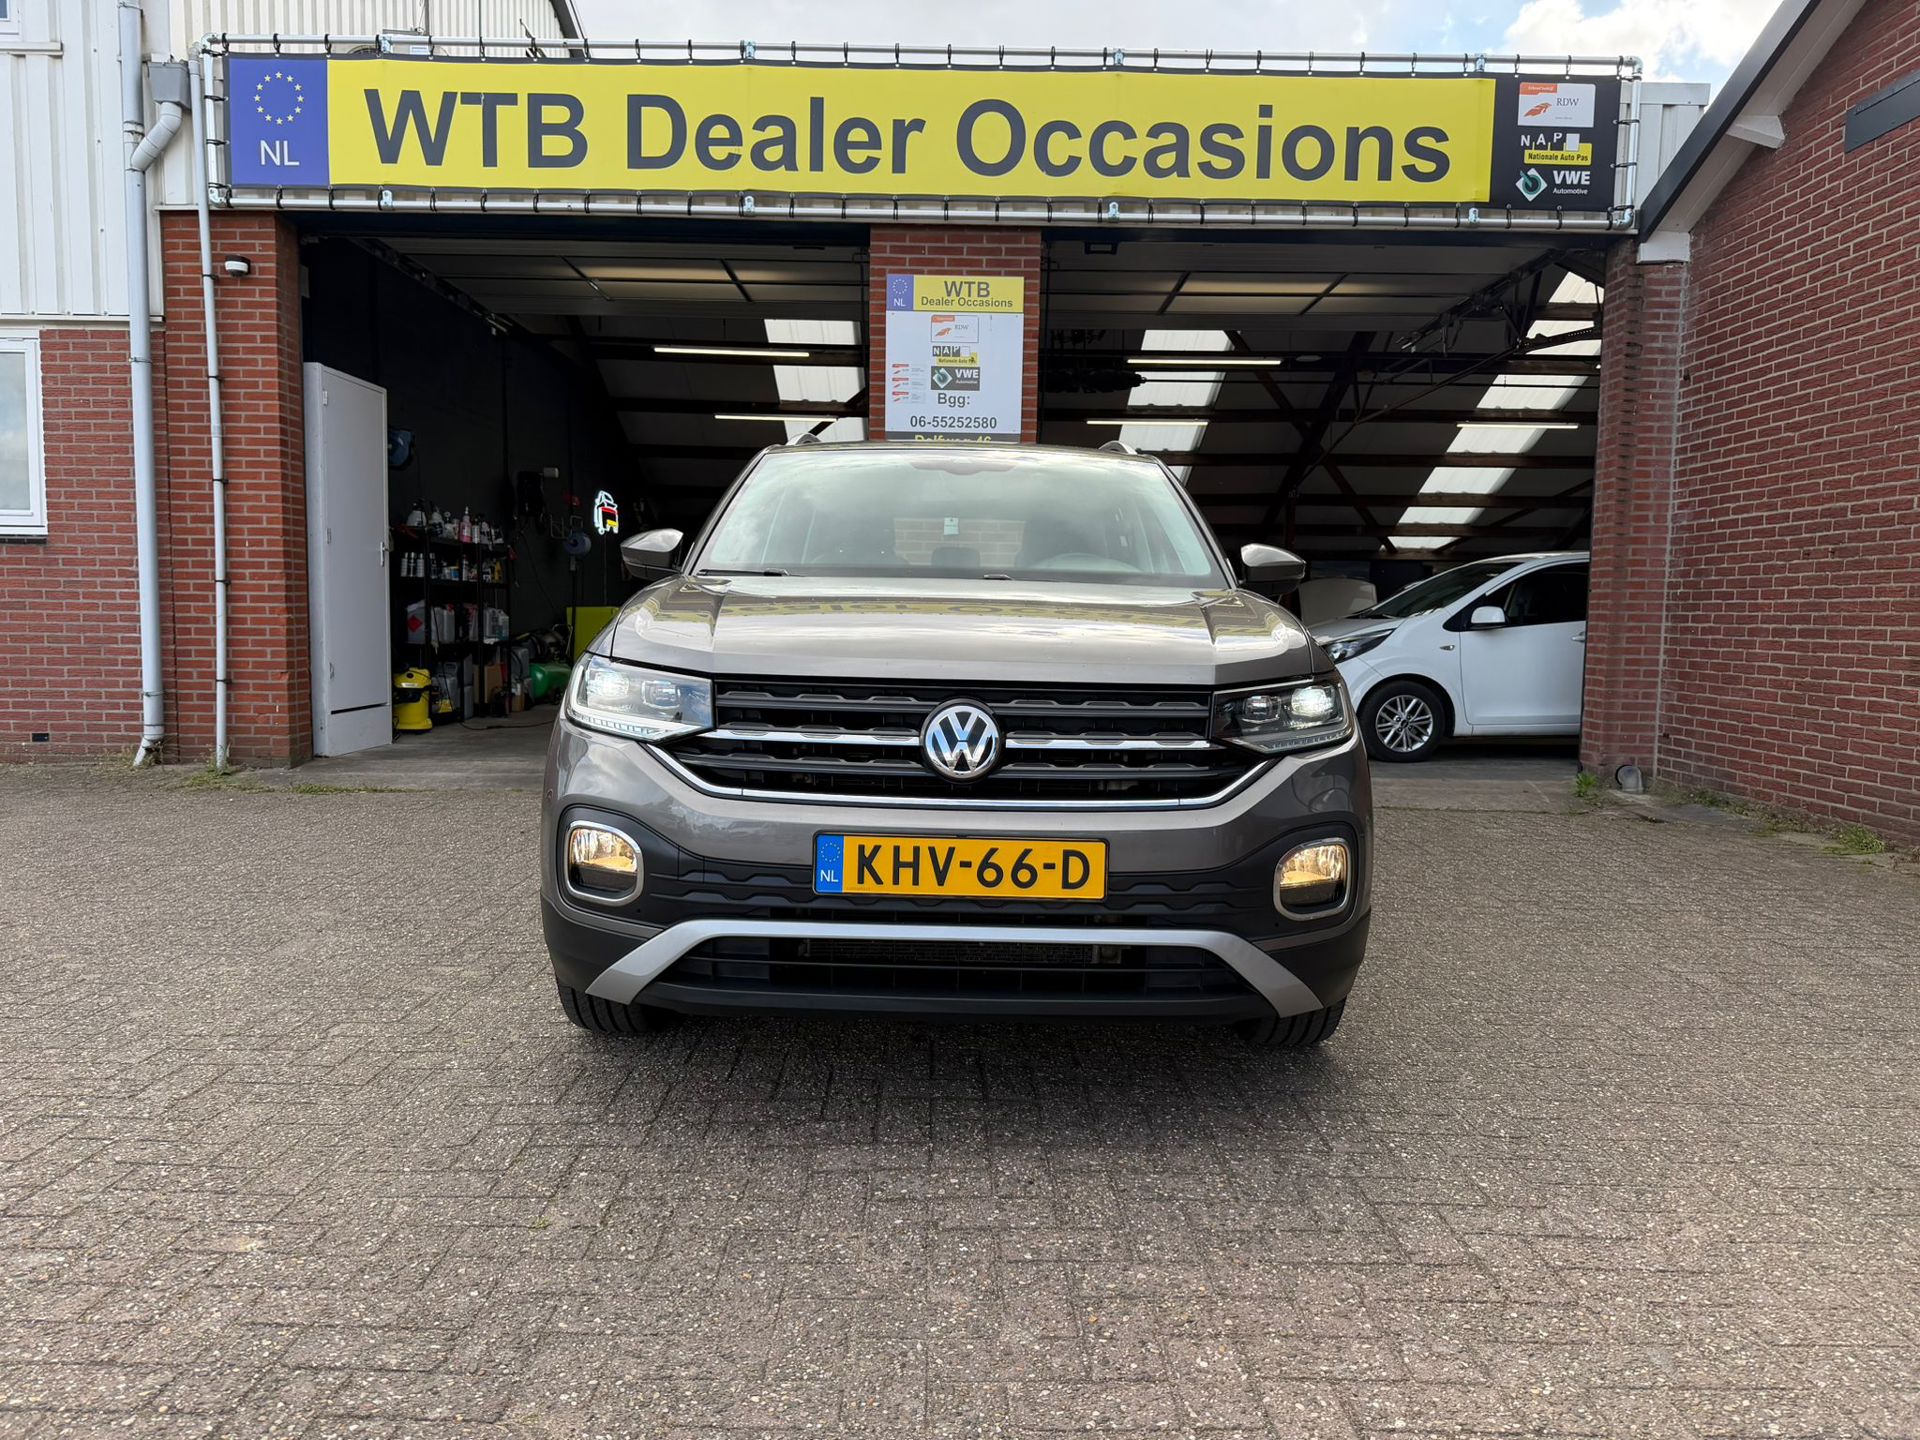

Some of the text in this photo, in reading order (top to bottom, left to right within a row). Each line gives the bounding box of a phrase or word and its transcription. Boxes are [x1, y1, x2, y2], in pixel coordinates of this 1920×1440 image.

[1556, 98, 1580, 106] RDW
[364, 88, 1450, 183] WTB Dealer Occasions
[260, 140, 300, 167] NL
[1528, 153, 1558, 161] Nationale
[1553, 170, 1591, 185] VWE
[944, 281, 990, 298] WTB
[893, 298, 906, 307] NL
[921, 296, 1013, 308] Dealer Occasions
[955, 369, 979, 379] VWE
[937, 393, 971, 408] Bgg:
[910, 415, 997, 429] 06-55252580
[820, 844, 1090, 890] NL KHV-66-D
